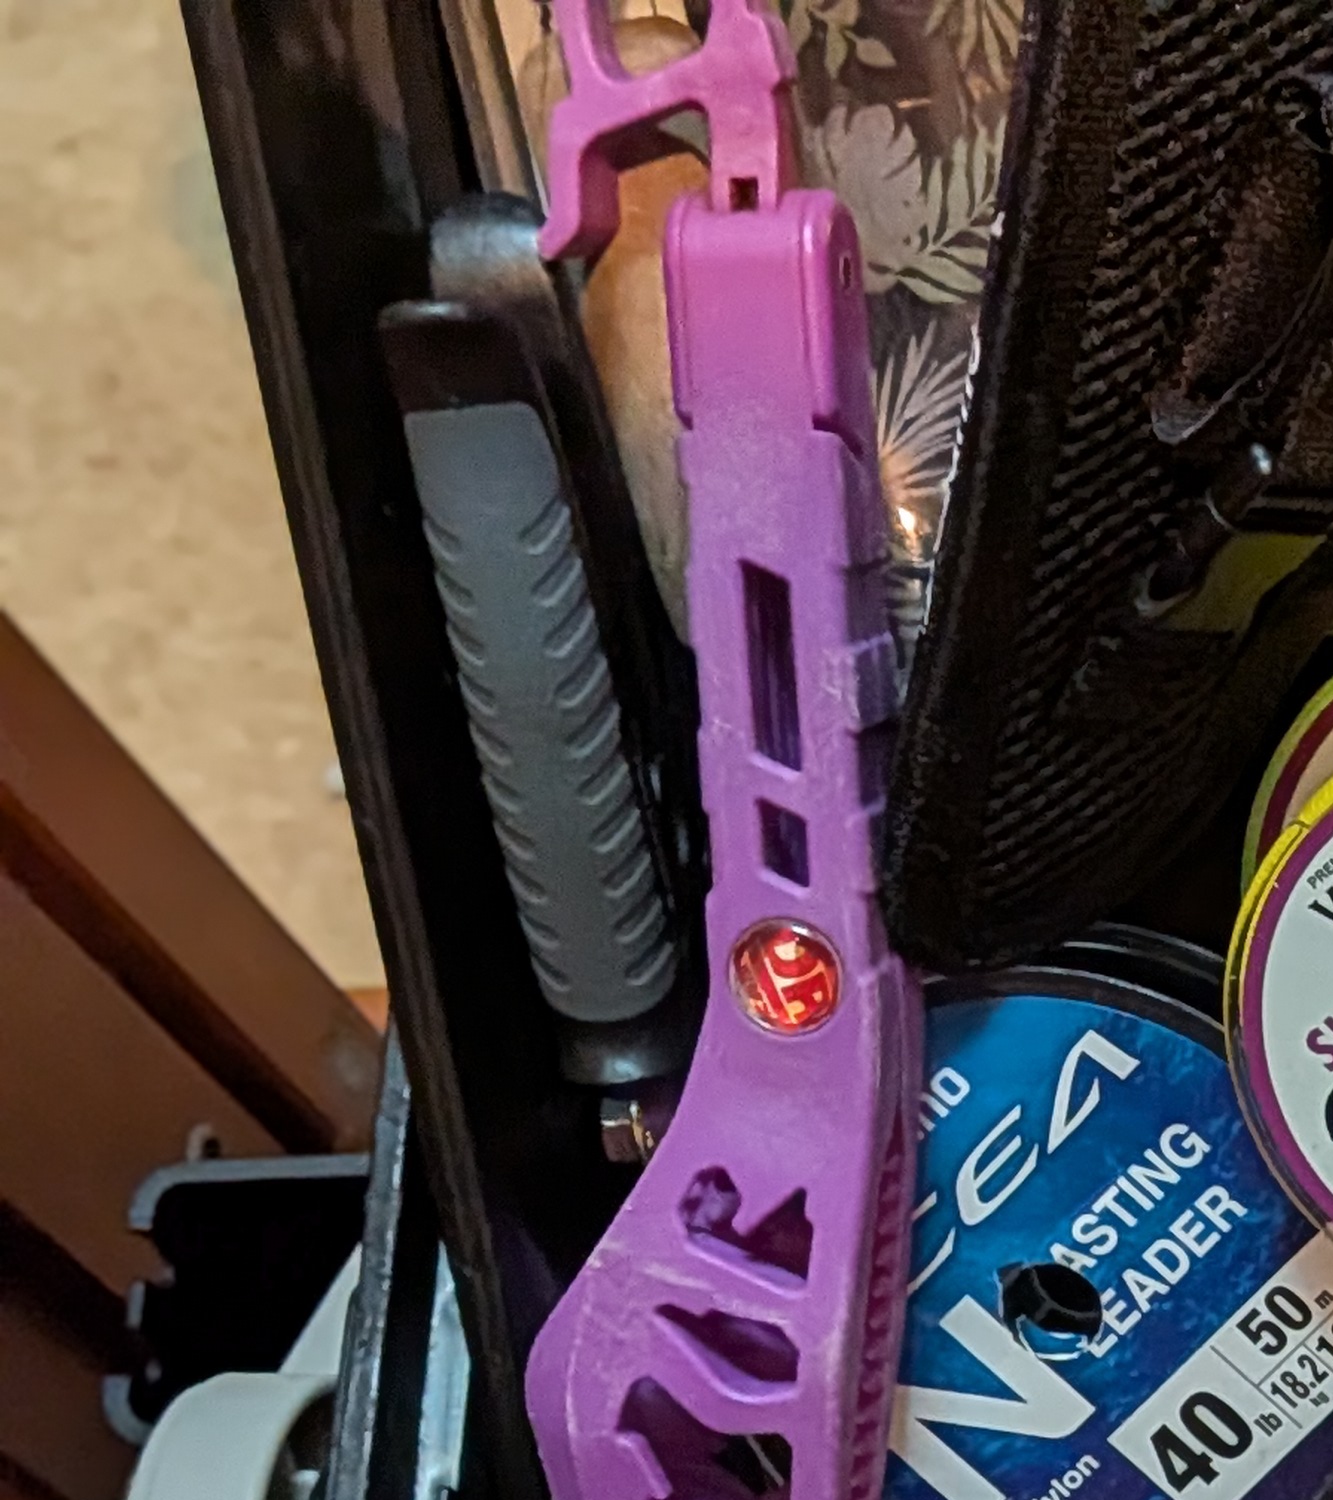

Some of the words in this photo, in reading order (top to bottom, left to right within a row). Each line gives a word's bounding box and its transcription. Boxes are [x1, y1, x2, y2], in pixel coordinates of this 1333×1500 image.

[1048, 1122, 1213, 1275] ASTING
[1235, 1285, 1313, 1356] 50
[1269, 1353, 1331, 1410] 18.2
[1149, 1390, 1254, 1494] 40
[1253, 1408, 1284, 1438] lb
